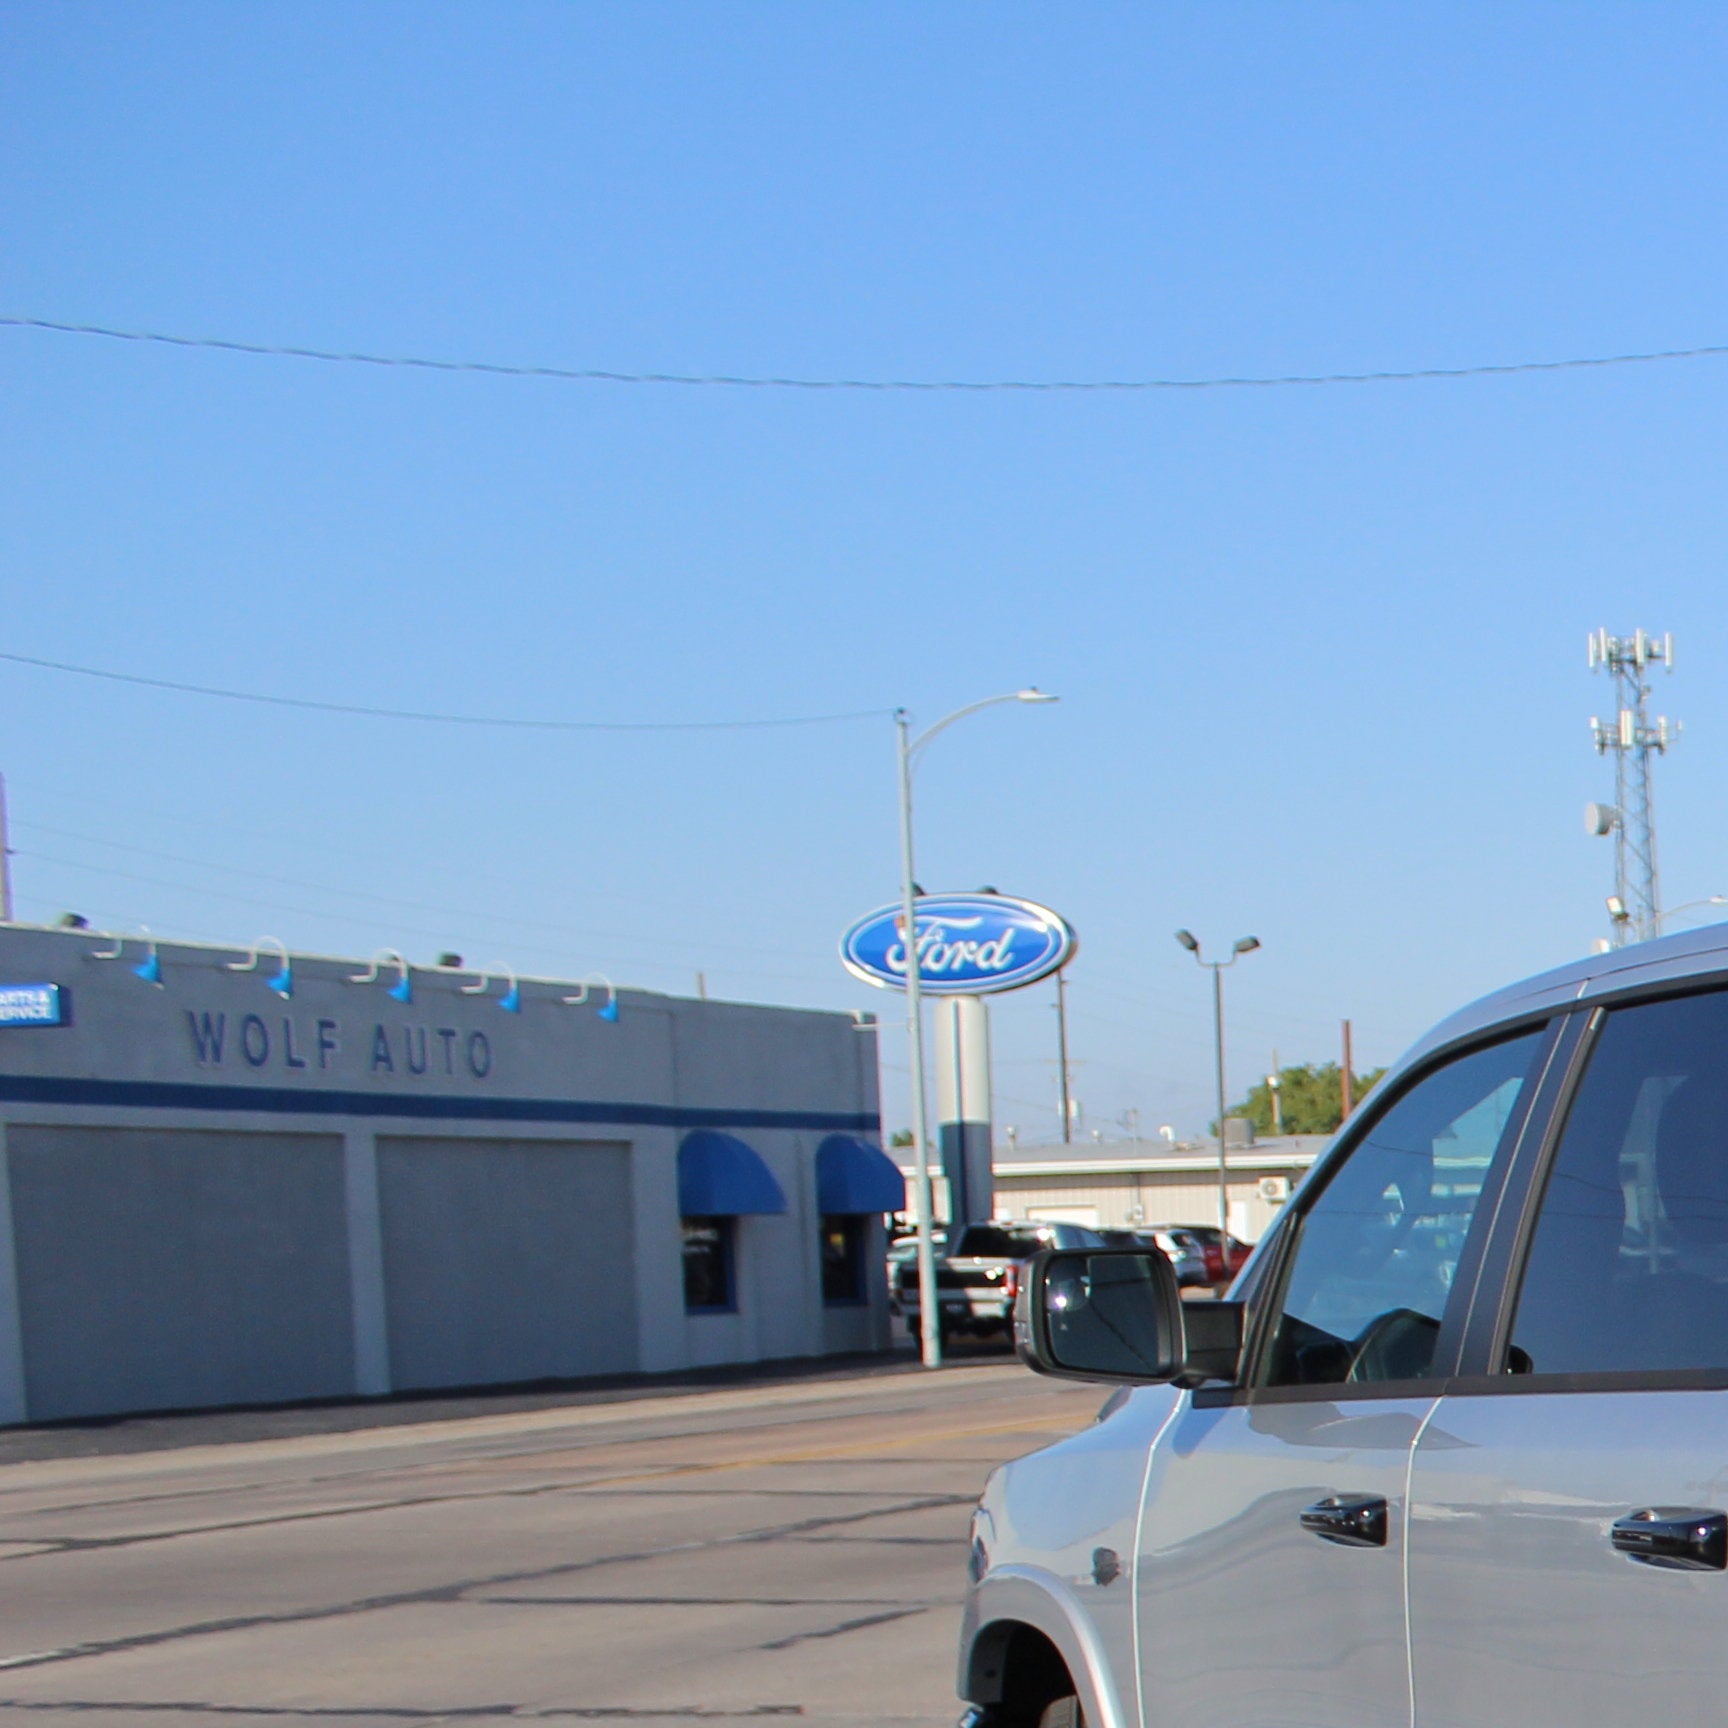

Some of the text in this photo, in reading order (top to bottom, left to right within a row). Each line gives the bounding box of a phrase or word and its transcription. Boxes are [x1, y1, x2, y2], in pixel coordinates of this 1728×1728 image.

[886, 915, 1016, 973] Ford
[185, 1009, 491, 1079] WOLF AUTO
